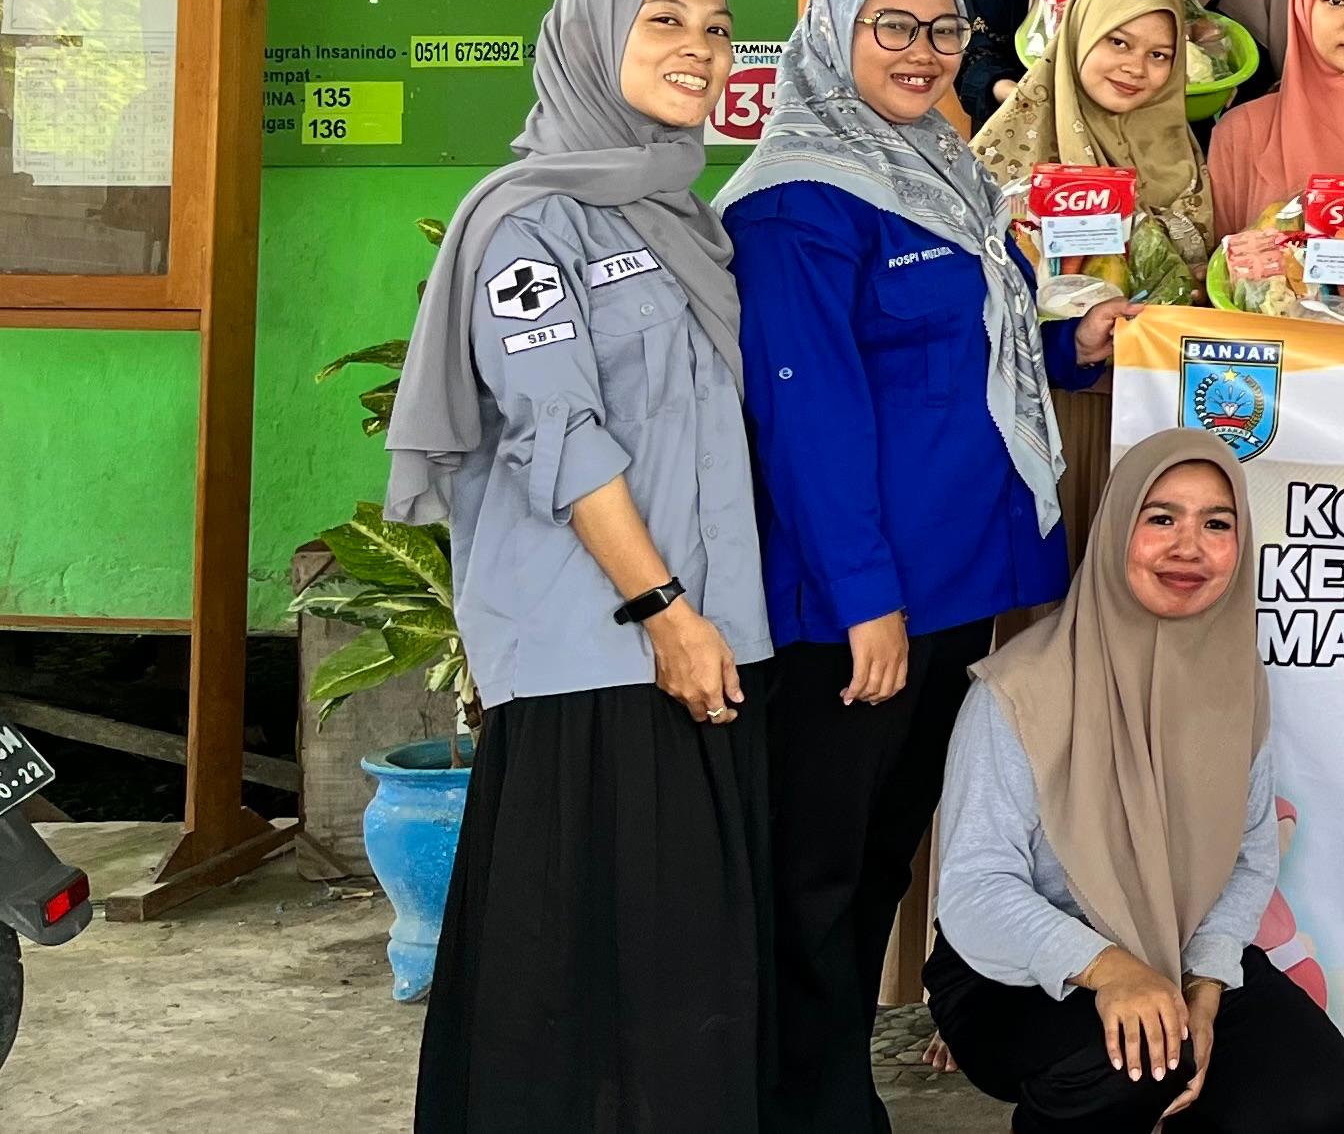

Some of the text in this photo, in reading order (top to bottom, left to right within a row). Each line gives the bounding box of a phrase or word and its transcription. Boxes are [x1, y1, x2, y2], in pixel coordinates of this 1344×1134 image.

[264, 45, 311, 63] ugrah
[317, 45, 396, 59] Insanindo
[415, 43, 448, 61] 0511
[456, 42, 519, 61] 6752992
[733, 45, 782, 54] TAMINA
[264, 68, 310, 85] empat
[263, 92, 295, 106] INA
[312, 87, 350, 107] 135
[308, 119, 347, 138] 136
[1053, 189, 1111, 212] SGM
[603, 255, 644, 278] FINA
[1188, 343, 1276, 361] BANJAR
